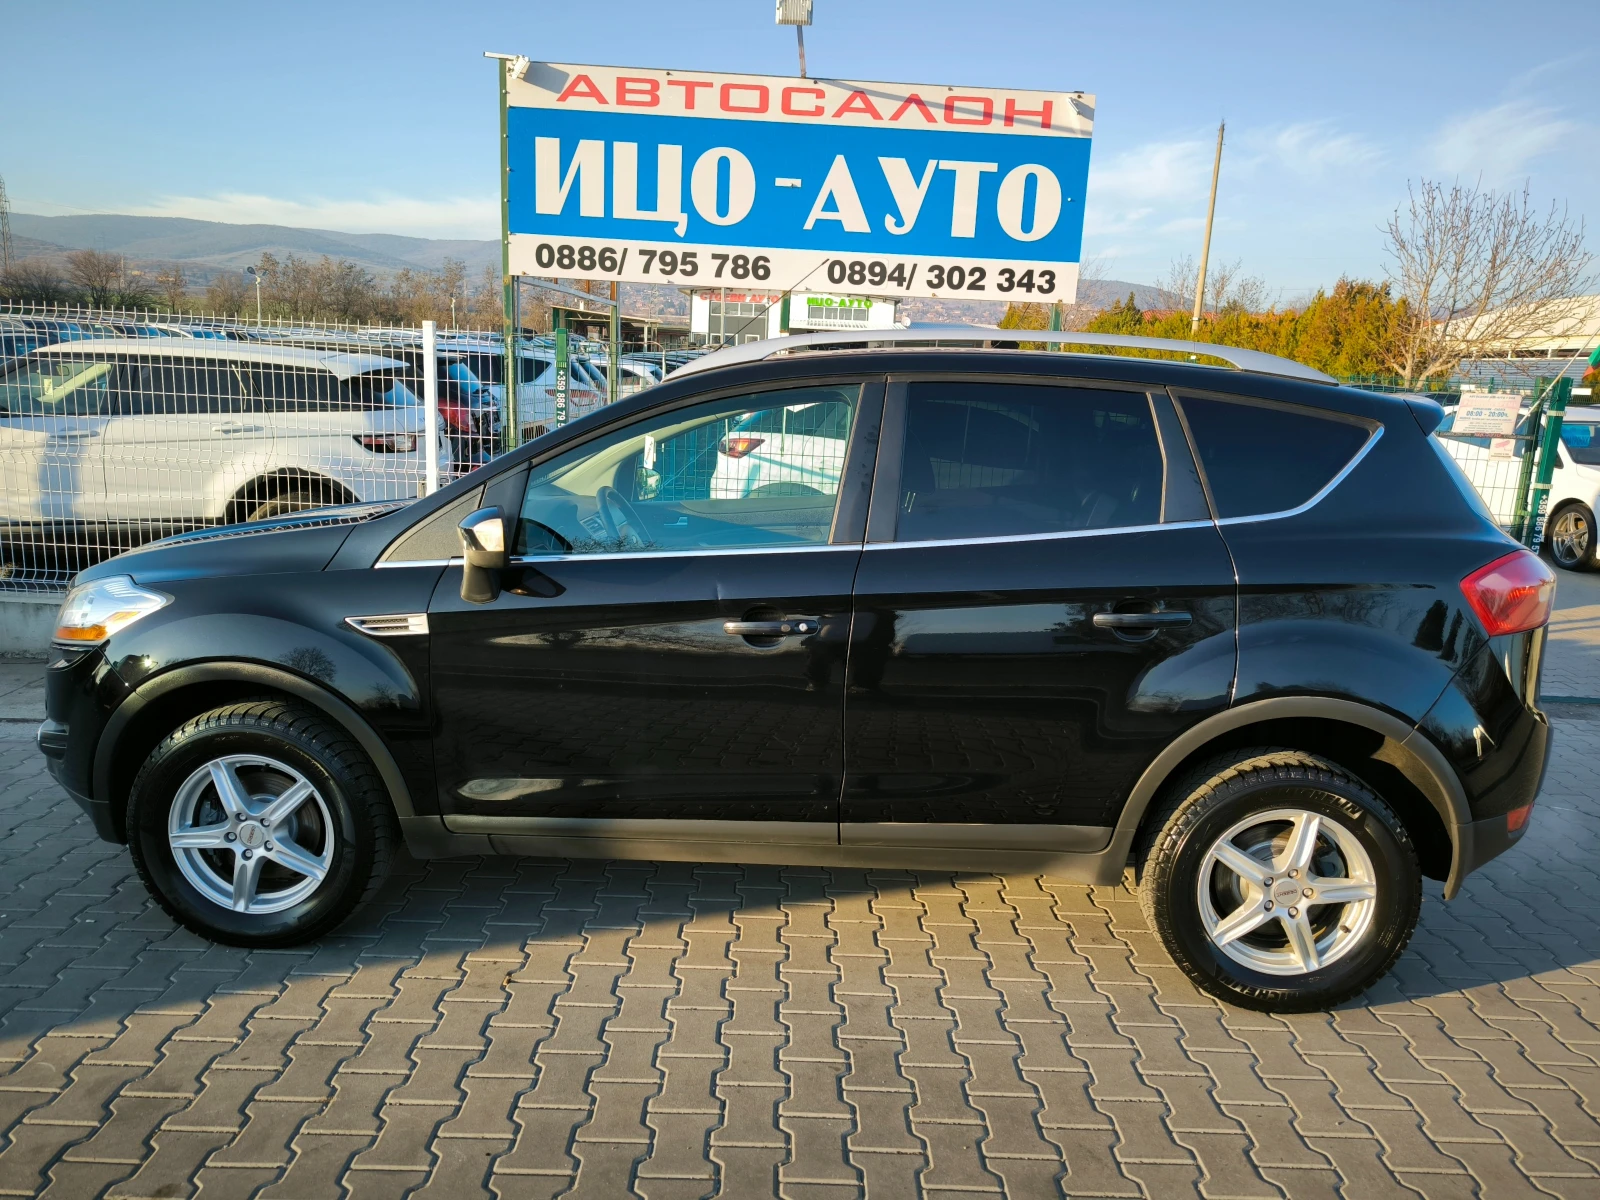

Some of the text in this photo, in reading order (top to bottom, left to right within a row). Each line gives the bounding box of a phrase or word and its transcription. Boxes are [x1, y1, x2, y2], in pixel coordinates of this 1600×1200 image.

[557, 74, 1054, 130] АВТОСАЛОН
[638, 249, 699, 278] 795
[711, 253, 771, 281] 786
[926, 264, 987, 291] 302
[996, 268, 1056, 295] 343
[556, 370, 566, 390] +359
[556, 393, 566, 408] 886
[557, 410, 566, 421] 79
[1537, 494, 1548, 515] +359
[1535, 516, 1546, 531] 886
